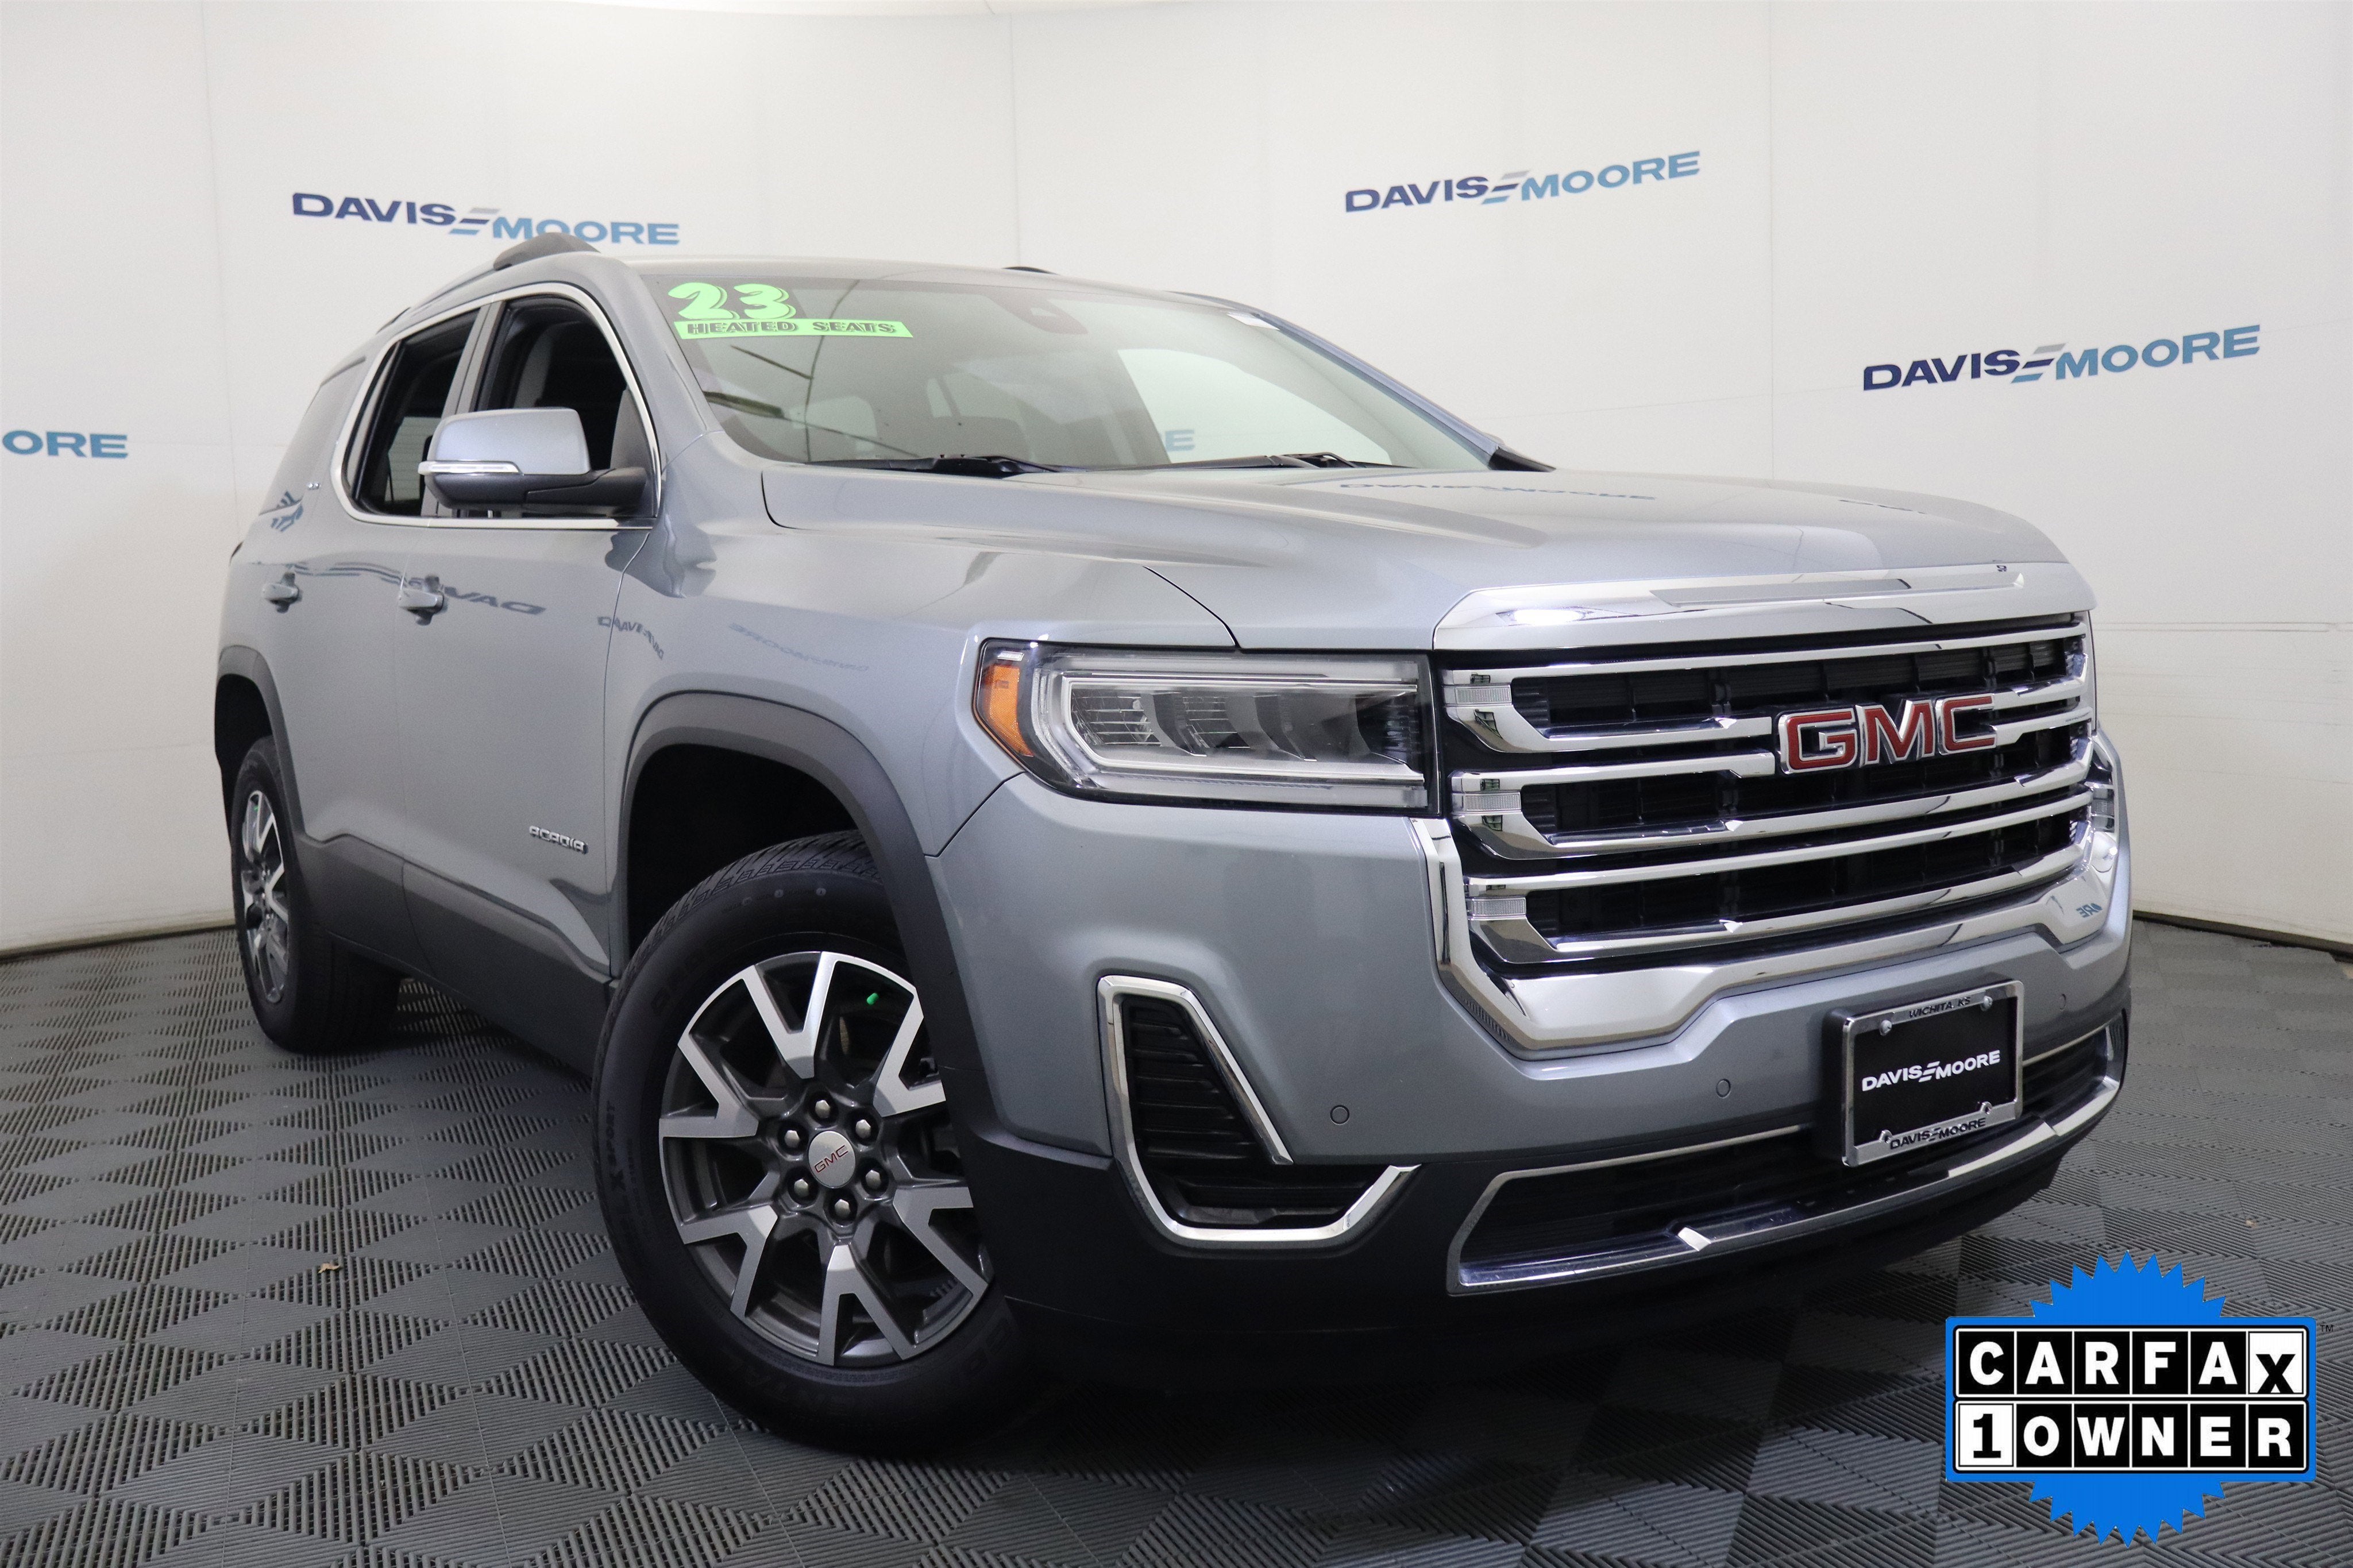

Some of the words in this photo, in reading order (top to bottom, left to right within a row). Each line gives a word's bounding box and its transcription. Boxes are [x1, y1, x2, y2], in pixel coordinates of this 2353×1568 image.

[1345, 176, 1489, 213] DAVIS
[1521, 150, 1701, 201] MOORE
[292, 192, 460, 226] DAVIS
[492, 217, 680, 245] MOORE
[668, 282, 797, 320] 23
[686, 320, 799, 335] HEATED
[812, 320, 897, 334] SEATS
[1863, 349, 2021, 391] DAVIS
[2055, 324, 2261, 380] MOORE
[1779, 693, 1997, 775] GMC
[529, 825, 588, 854] ACADIA
[1958, 997, 1971, 1007] KS
[1862, 1065, 1923, 1091] DAVIS
[1935, 1049, 2001, 1080] MOORE
[1890, 1130, 1930, 1149] DAVIS
[1939, 1117, 1986, 1140] MOORE
[815, 1145, 849, 1173] GMC
